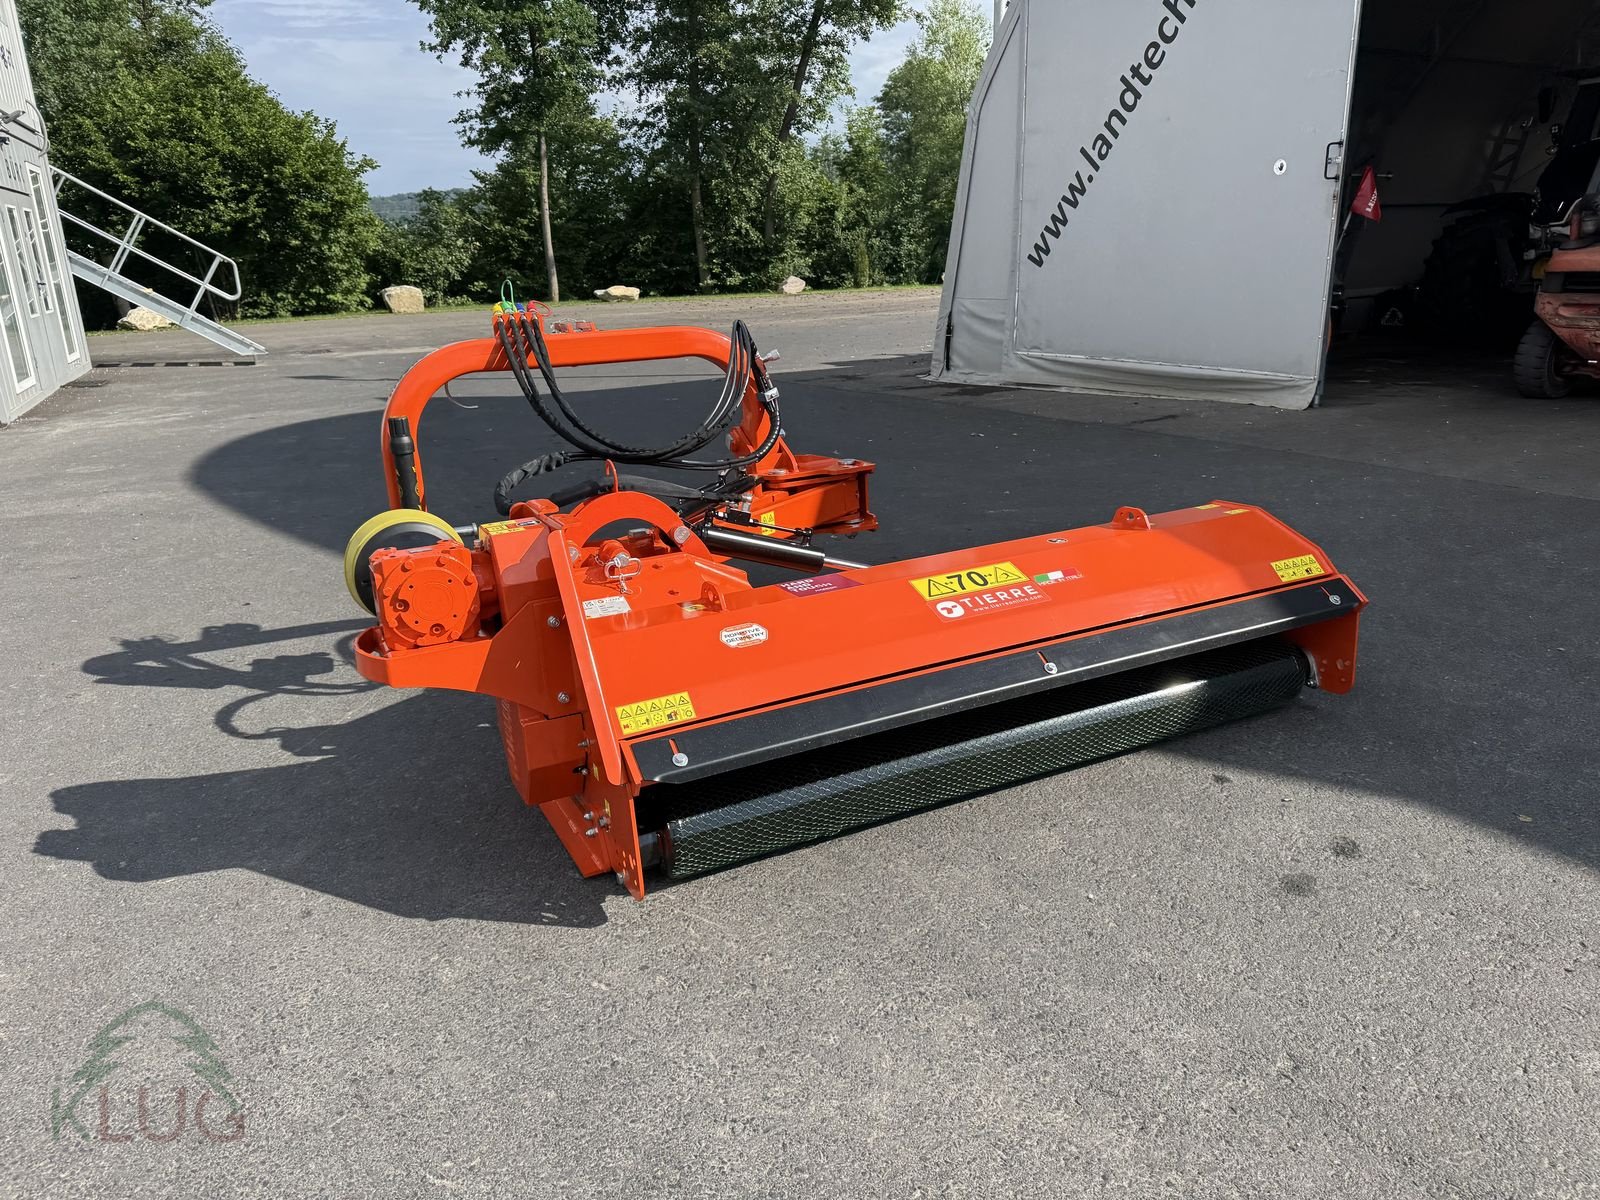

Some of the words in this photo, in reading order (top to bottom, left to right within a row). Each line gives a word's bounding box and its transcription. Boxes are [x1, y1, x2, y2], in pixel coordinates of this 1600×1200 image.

[946, 571, 989, 591] 70
[960, 585, 1039, 608] TIERRE
[973, 595, 1044, 612] www.tierreonline.com
